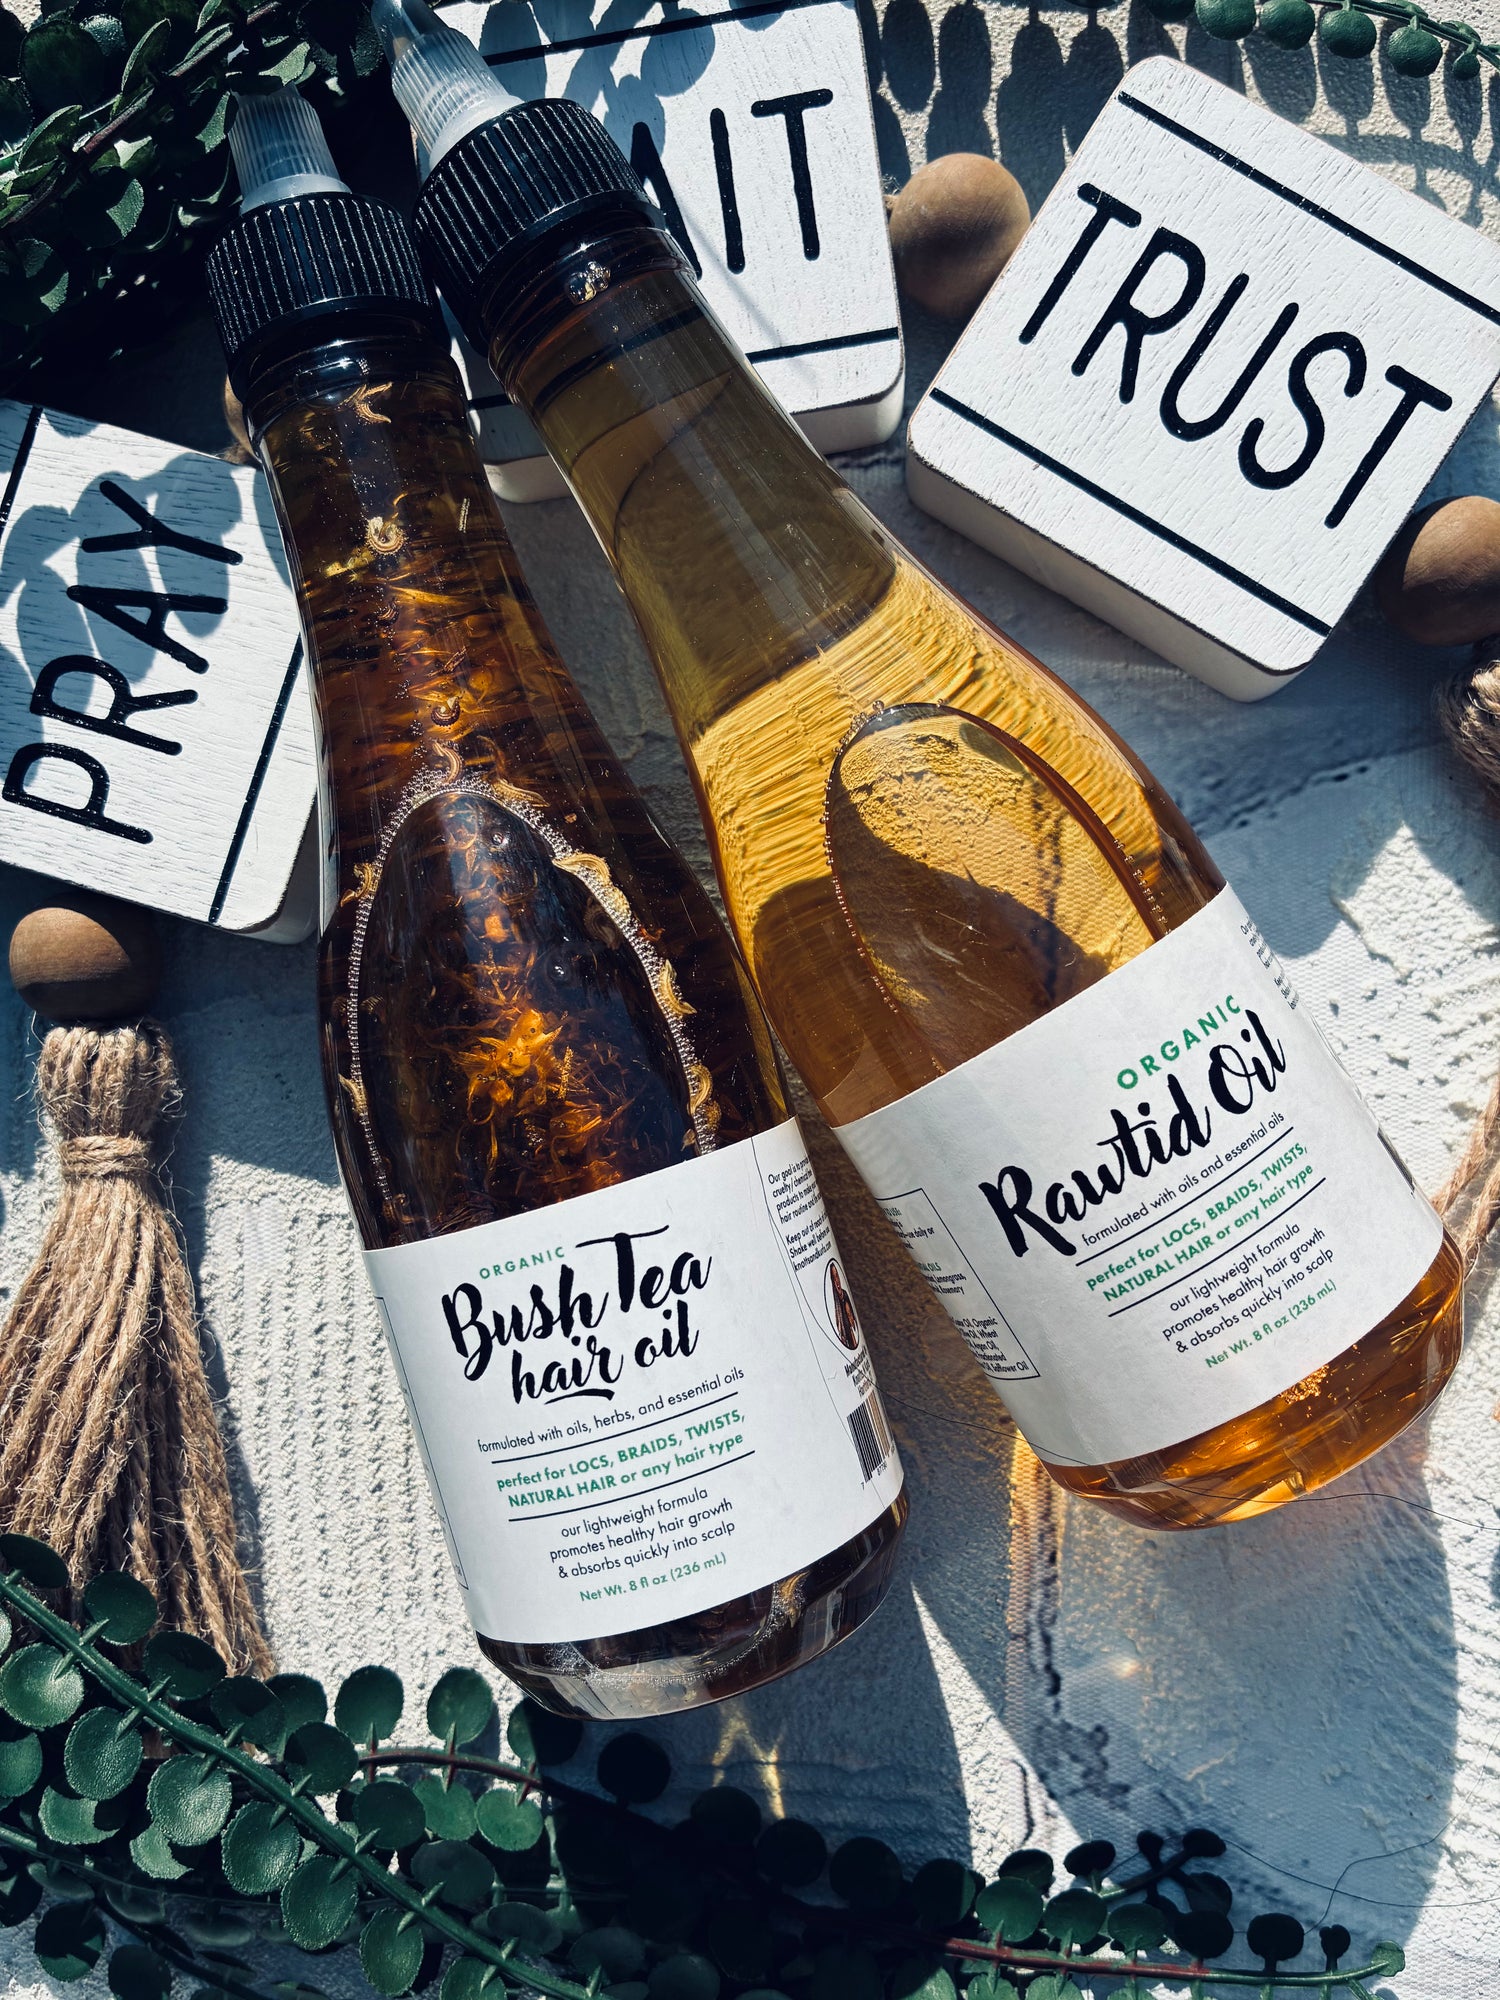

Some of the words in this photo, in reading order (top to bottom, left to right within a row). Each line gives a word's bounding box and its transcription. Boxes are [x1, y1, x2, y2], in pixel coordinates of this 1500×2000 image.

[631, 88, 834, 281] AIT
[1019, 182, 1454, 530] TRUST
[1, 480, 244, 844] PRAY
[1116, 994, 1242, 1090] ORGANIC
[768, 1173, 780, 1185] Our
[781, 1164, 792, 1181] goal
[977, 1073, 1212, 1258] Rawtid
[1208, 1008, 1287, 1115] Oil
[776, 1193, 799, 1212] products
[779, 1211, 792, 1225] hair
[792, 1203, 808, 1217] routine
[1082, 1202, 1149, 1247] formulated
[1150, 1187, 1177, 1210] with
[1178, 1175, 1199, 1193] oils
[1200, 1157, 1224, 1179] and
[1224, 1121, 1268, 1162] essential
[1267, 1111, 1285, 1130] oils
[1086, 1255, 1137, 1291] perfect
[1137, 1244, 1161, 1264] for
[1161, 1217, 1206, 1249] LOCS,
[1205, 1178, 1263, 1220] BRAIDS,
[1261, 1142, 1308, 1182] TWISTS,
[479, 1246, 566, 1280] ORGANIC
[785, 1232, 802, 1248] Keep
[801, 1226, 810, 1238] out
[789, 1244, 808, 1259] Shake
[808, 1233, 817, 1249] well
[1103, 1259, 1175, 1302] NATURAL
[1174, 1235, 1215, 1264] HAIR
[1216, 1225, 1232, 1241] or
[1233, 1206, 1260, 1229] any
[1261, 1184, 1287, 1211] hair
[1286, 1164, 1314, 1191] type
[1169, 1294, 1190, 1312] our
[1189, 1252, 1258, 1299] lightweight
[1256, 1223, 1300, 1258] formula
[441, 1264, 609, 1381] Bush
[575, 1224, 712, 1313] Tea
[972, 1316, 998, 1330] Organic
[1162, 1301, 1220, 1341] promotes
[1218, 1274, 1264, 1307] healthy
[1263, 1256, 1289, 1279] hair
[1289, 1228, 1326, 1264] growth
[1175, 1340, 1189, 1353] &
[1190, 1313, 1240, 1347] absorbs
[1241, 1285, 1282, 1319] quickly
[1282, 1271, 1306, 1291] into
[1306, 1248, 1334, 1275] scalp
[1205, 1349, 1230, 1368] Net
[1229, 1337, 1253, 1355] Wt.
[1252, 1330, 1263, 1342] 8
[1262, 1323, 1273, 1336] fl
[1274, 1314, 1290, 1329] oz
[1288, 1294, 1316, 1320] (236
[1316, 1279, 1338, 1301] mL)
[511, 1335, 624, 1404] hair
[634, 1299, 700, 1368] oil
[1016, 1360, 1029, 1371] Oil
[477, 1431, 535, 1453] formulated
[537, 1427, 563, 1443] with
[566, 1420, 592, 1436] oils,
[593, 1409, 635, 1430] herbs,
[638, 1393, 665, 1416] and
[667, 1373, 721, 1406] essential
[723, 1366, 745, 1385] oils
[496, 1470, 542, 1492] perfect
[544, 1466, 566, 1481] for
[568, 1456, 614, 1476] LOCS,
[617, 1433, 683, 1463] BRAIDS,
[684, 1408, 745, 1442] TWISTS,
[508, 1485, 575, 1508] NATURAL
[576, 1474, 618, 1495] HAIR
[620, 1472, 637, 1484] or
[641, 1461, 671, 1481] any
[674, 1446, 706, 1467] hair
[709, 1433, 744, 1455] type
[561, 1525, 581, 1538] our
[583, 1504, 655, 1535] lightweight
[657, 1486, 708, 1513] formula
[549, 1540, 605, 1563] promotes
[607, 1526, 655, 1549] healthy
[657, 1517, 684, 1535] hair
[688, 1498, 733, 1528] growth
[558, 1566, 568, 1579] &
[571, 1555, 621, 1576] absorbs
[624, 1542, 670, 1567] quickly
[673, 1535, 698, 1552] into
[701, 1520, 736, 1542] scalp
[580, 1589, 602, 1602] Net
[603, 1584, 627, 1597] Wt.
[629, 1580, 638, 1592] 8
[640, 1576, 649, 1588] fl
[652, 1573, 668, 1585] oz
[670, 1561, 701, 1582] (236
[704, 1551, 727, 1570] mL)
